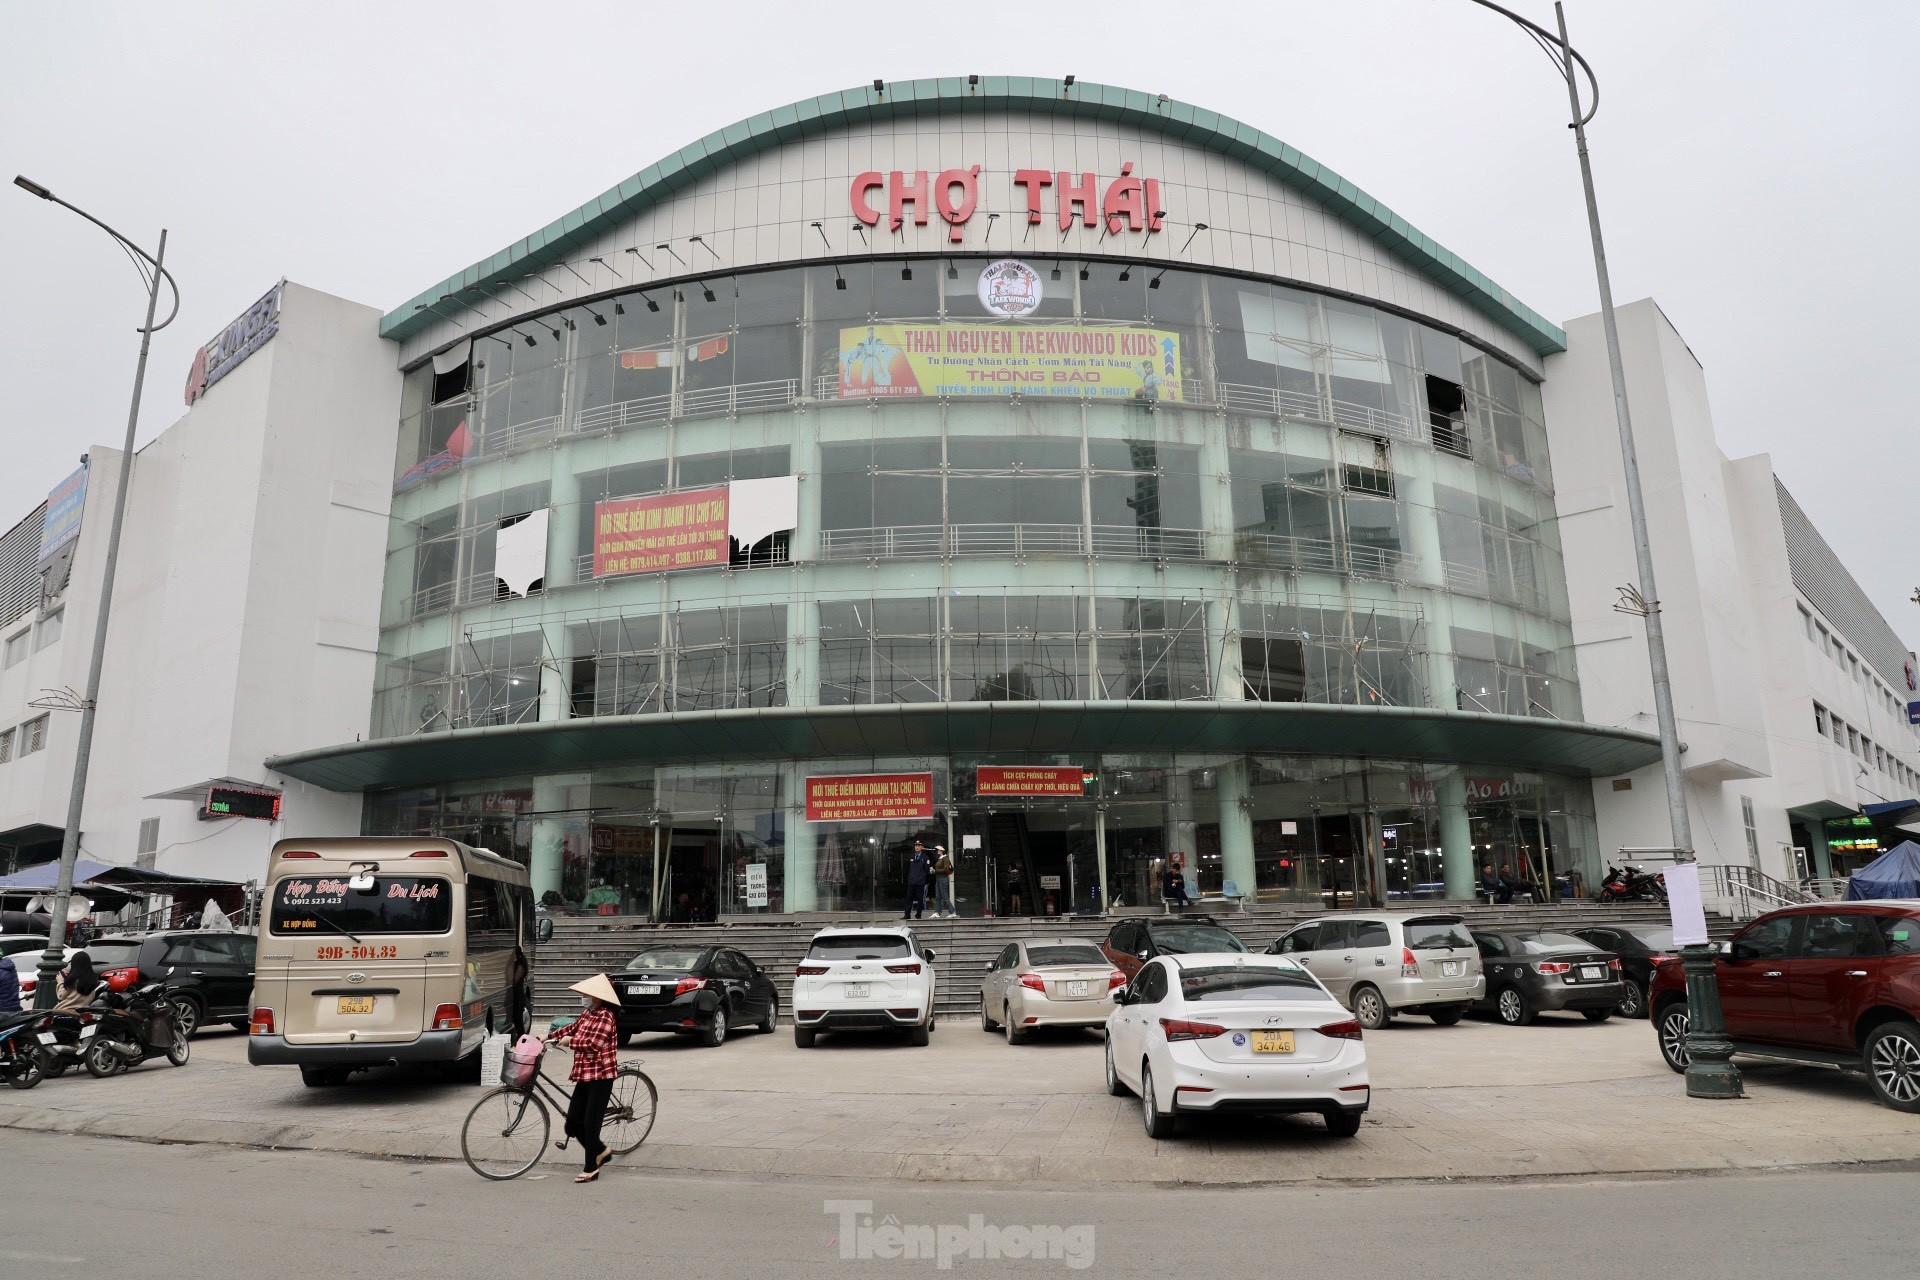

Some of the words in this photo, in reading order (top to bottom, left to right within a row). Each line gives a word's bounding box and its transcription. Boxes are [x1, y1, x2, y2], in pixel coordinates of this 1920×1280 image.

[850, 164, 980, 243] CHỢ
[1014, 161, 1162, 236] THÁI
[905, 330, 941, 353] THAI
[947, 330, 1012, 354] NGUYEN
[1017, 331, 1115, 356] TAEKWONDO
[1121, 333, 1157, 357] KIDS
[965, 368, 1044, 382] THÔNG
[1052, 369, 1101, 382] BÁO
[843, 387, 870, 397] Hotline:
[889, 386, 901, 395] 611
[904, 386, 917, 394] 289
[970, 385, 994, 395] SINH
[646, 508, 661, 531] KINH
[663, 505, 684, 528] DOANH
[686, 503, 696, 529] TẠI
[696, 501, 710, 527] CHỢ
[611, 542, 624, 553] GIAN
[677, 533, 688, 546] LÊN
[706, 529, 725, 542] THÁNG
[605, 557, 619, 572] LIÊN
[1003, 771, 1014, 779] TÍCH
[1015, 771, 1026, 781] CỰC
[1026, 771, 1044, 780] PHÒNG
[1044, 771, 1057, 780] CHÁY
[839, 779, 854, 796] ĐIỂM
[855, 783, 869, 796] KINH
[870, 783, 889, 795] DOANH
[890, 782, 899, 797] TẠI
[900, 781, 912, 796] CHỢ
[913, 779, 926, 793] THÁI
[1020, 781, 1034, 791] CHÁY
[836, 799, 856, 807] KHUYẾN
[866, 798, 874, 806] CÓ
[874, 798, 884, 806] THỂ
[910, 797, 927, 805] THÁNG
[820, 810, 833, 818] LIÊN
[833, 810, 842, 820] HỆ:
[286, 880, 312, 898] Hợp
[316, 879, 350, 897] Đồng
[388, 883, 408, 898] Du
[409, 883, 439, 901] Lịch
[283, 920, 290, 928] XE
[290, 920, 301, 929] HỢP
[301, 919, 316, 928] ĐỒNG
[1072, 981, 1083, 989] 20A
[348, 997, 364, 1005] 29B
[341, 1005, 369, 1013] 504.32
[1263, 1031, 1282, 1040] 20A
[1257, 1041, 1290, 1051] 347.46
